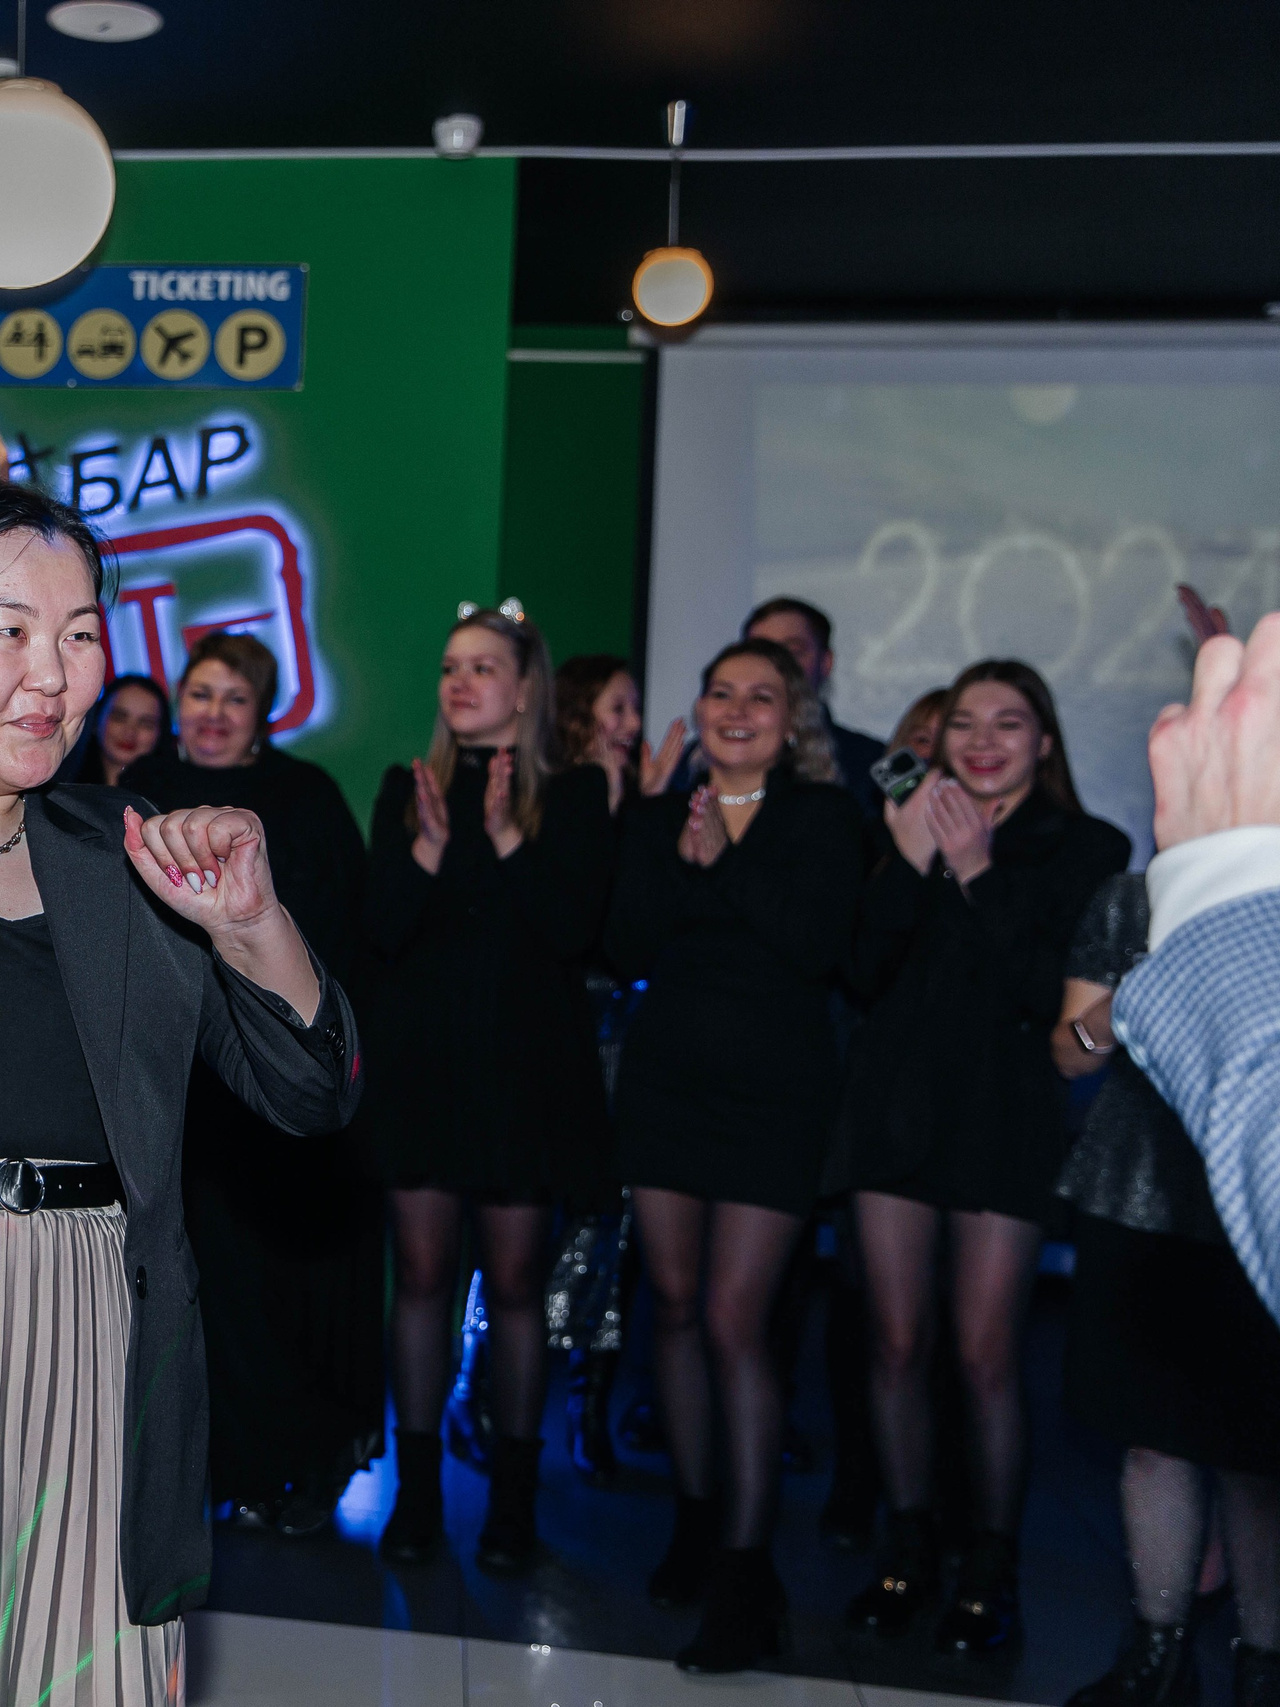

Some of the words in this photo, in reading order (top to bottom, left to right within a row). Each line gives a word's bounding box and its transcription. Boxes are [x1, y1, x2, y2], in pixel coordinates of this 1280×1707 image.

[129, 269, 291, 302] TICKETING
[236, 323, 270, 369] P
[71, 424, 250, 516] БАР
